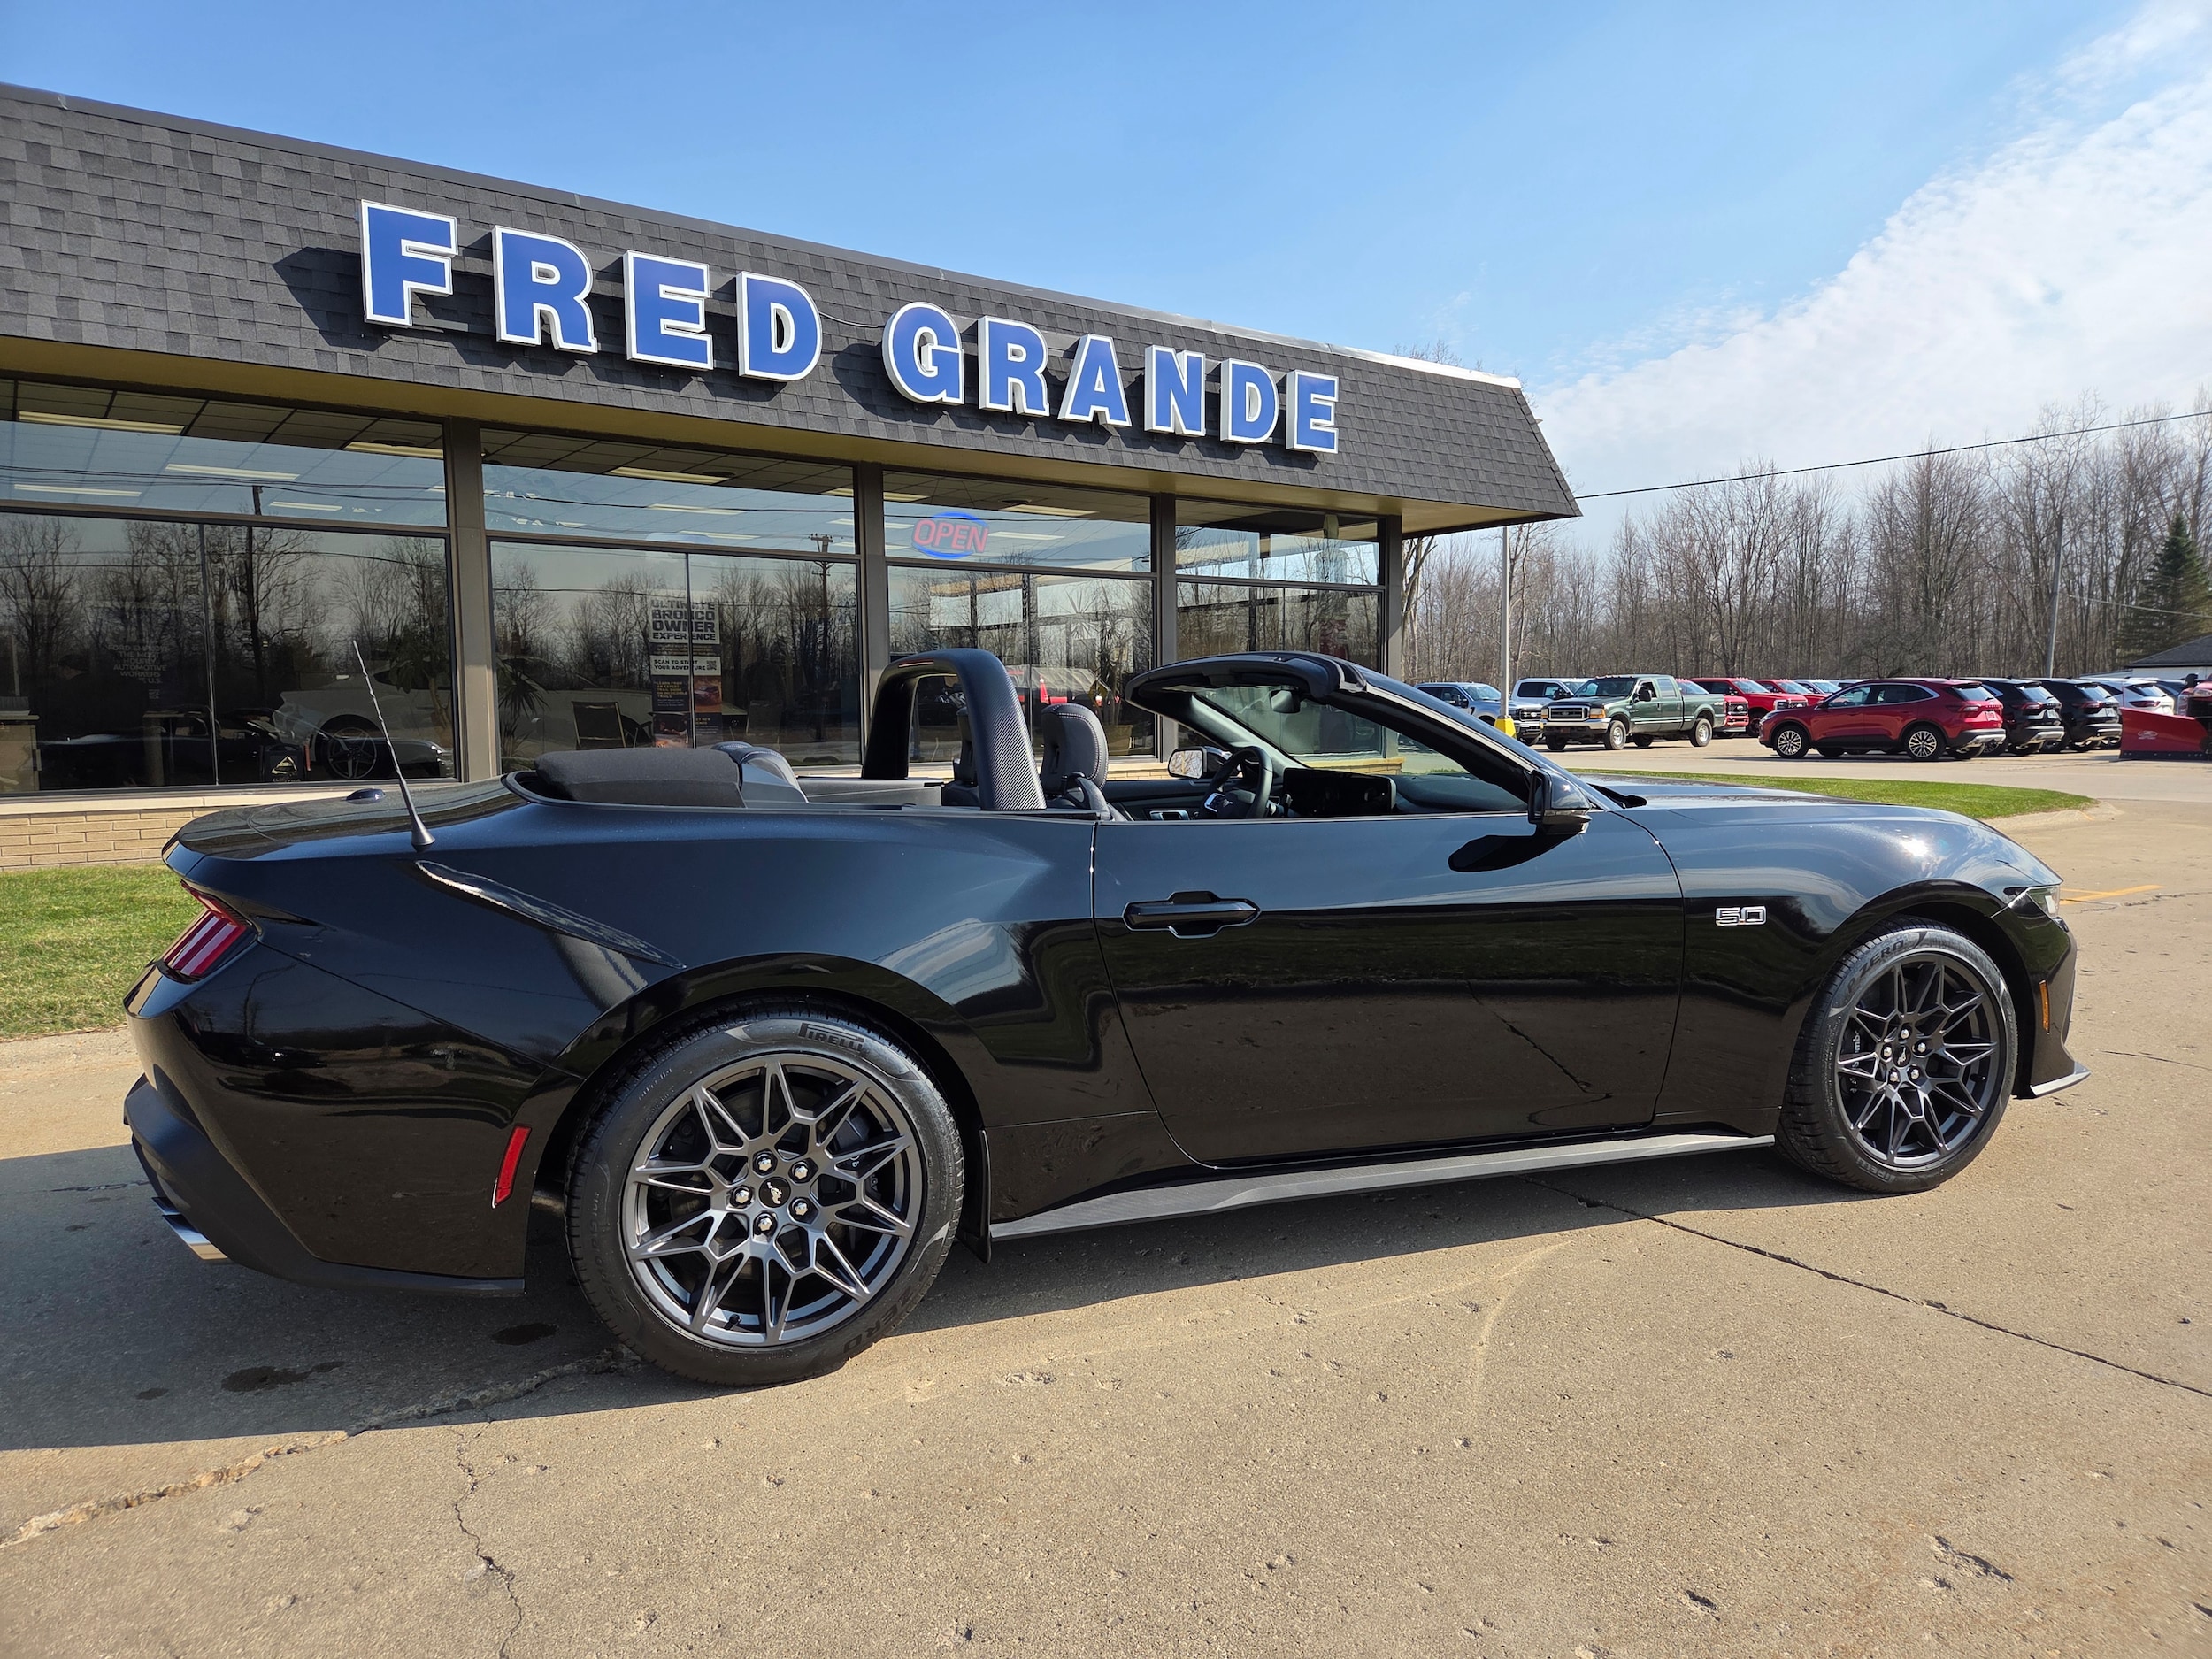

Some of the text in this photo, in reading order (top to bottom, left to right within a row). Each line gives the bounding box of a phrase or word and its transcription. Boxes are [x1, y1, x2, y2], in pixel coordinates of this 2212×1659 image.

[361, 199, 1340, 455] FRED GRANDE
[913, 519, 989, 553] OPEN
[652, 610, 716, 621] BRONCO
[652, 620, 716, 633] OWNER
[652, 632, 716, 641] EXPERENCE
[1859, 940, 1904, 978] ZERO
[798, 1022, 864, 1053] PIRELLI
